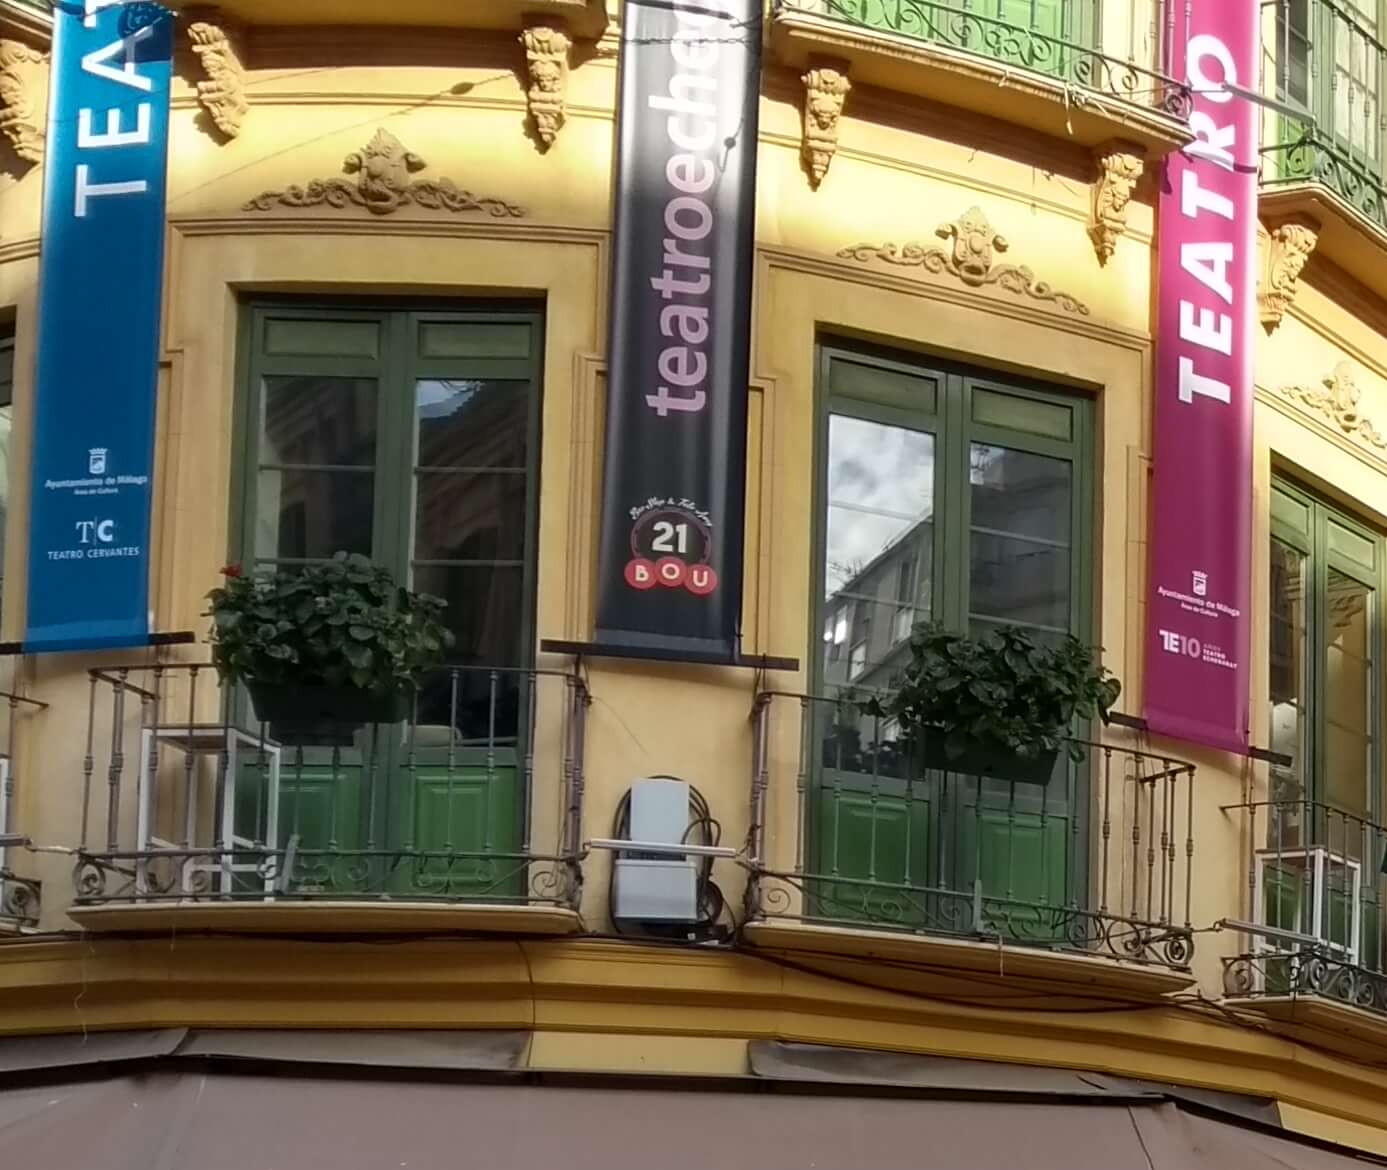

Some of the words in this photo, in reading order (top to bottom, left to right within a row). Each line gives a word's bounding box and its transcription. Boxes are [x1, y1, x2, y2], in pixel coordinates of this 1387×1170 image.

[1177, 34, 1238, 405] TEATRO
[651, 520, 688, 554] 21
[47, 549, 85, 561] TEATRO
[86, 546, 140, 559] CERVANTES
[634, 563, 709, 588] BOU
